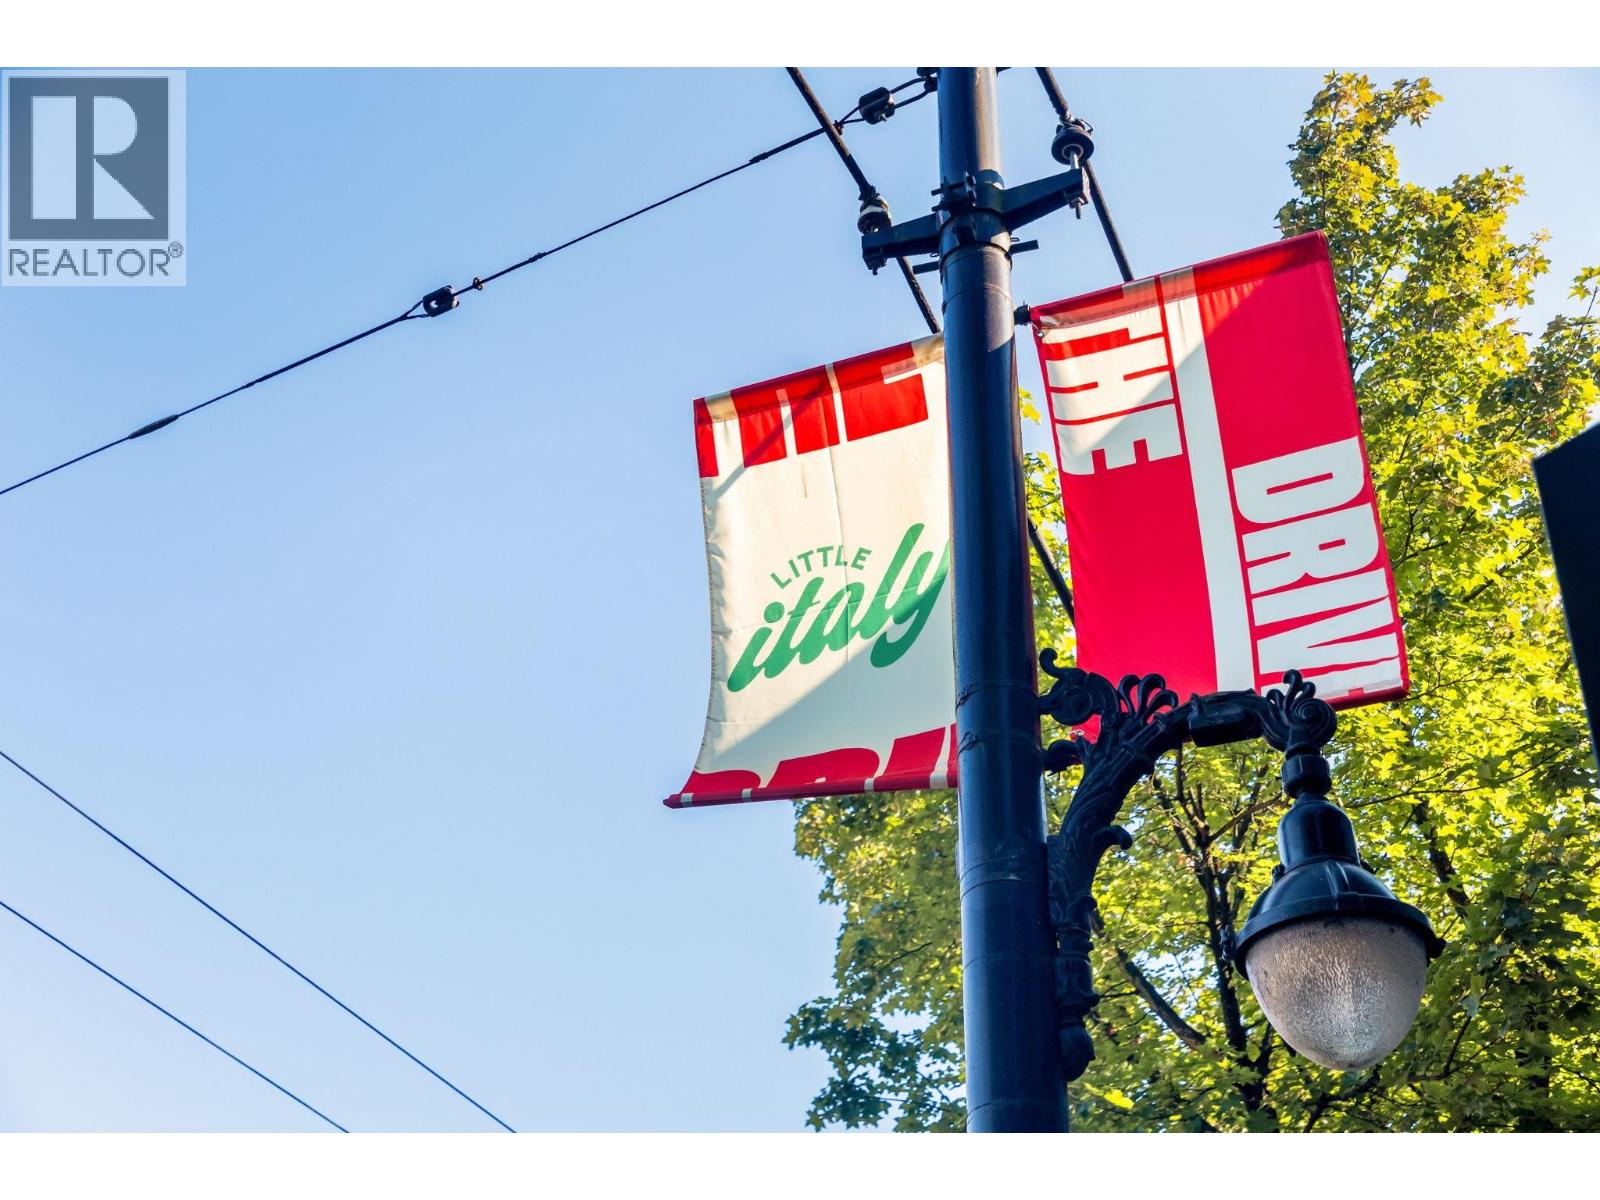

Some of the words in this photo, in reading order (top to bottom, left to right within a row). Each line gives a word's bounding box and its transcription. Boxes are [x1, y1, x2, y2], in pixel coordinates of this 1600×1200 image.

[1039, 305, 1183, 476] THE
[727, 523, 950, 692] italy
[770, 545, 872, 589] LITTLE
